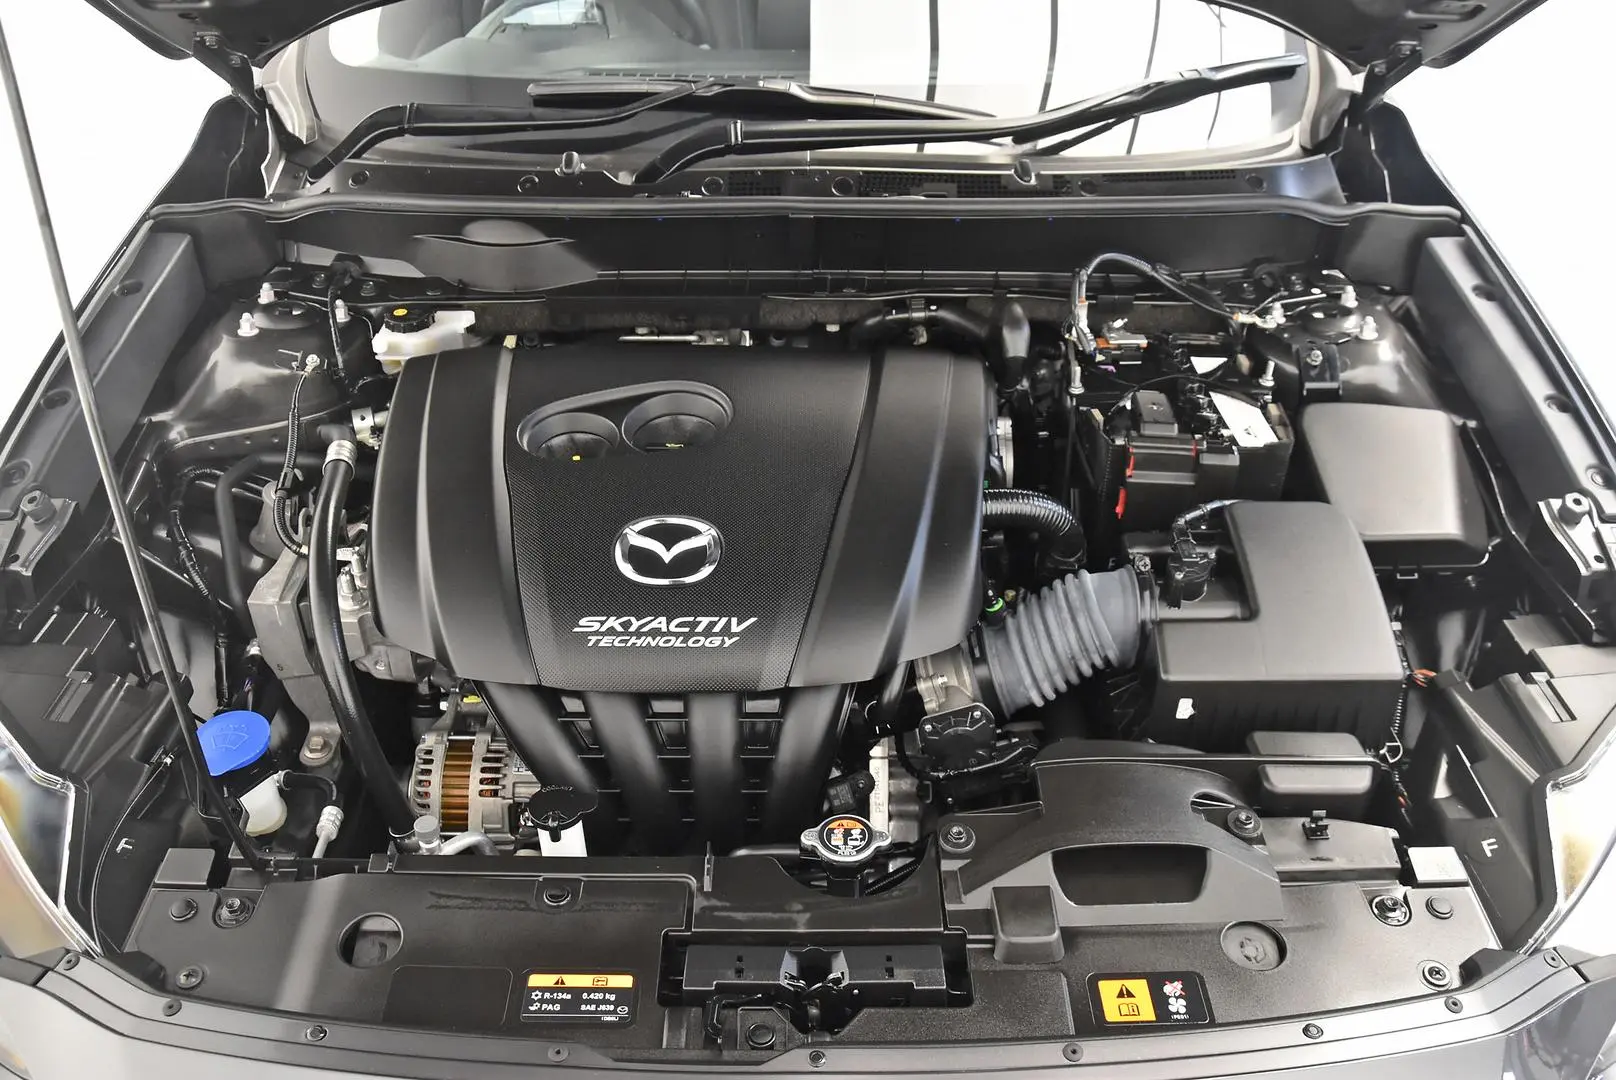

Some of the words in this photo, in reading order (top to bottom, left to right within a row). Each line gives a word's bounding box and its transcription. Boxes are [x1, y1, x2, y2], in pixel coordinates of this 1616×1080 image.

[572, 616, 758, 632] SKYACTIV
[587, 635, 740, 648] TECHNOLOGY
[1481, 838, 1499, 858] F
[543, 992, 572, 1000] R-134a
[582, 992, 603, 1000] 0.420
[605, 992, 616, 1001] kg
[541, 1003, 561, 1011] PAG
